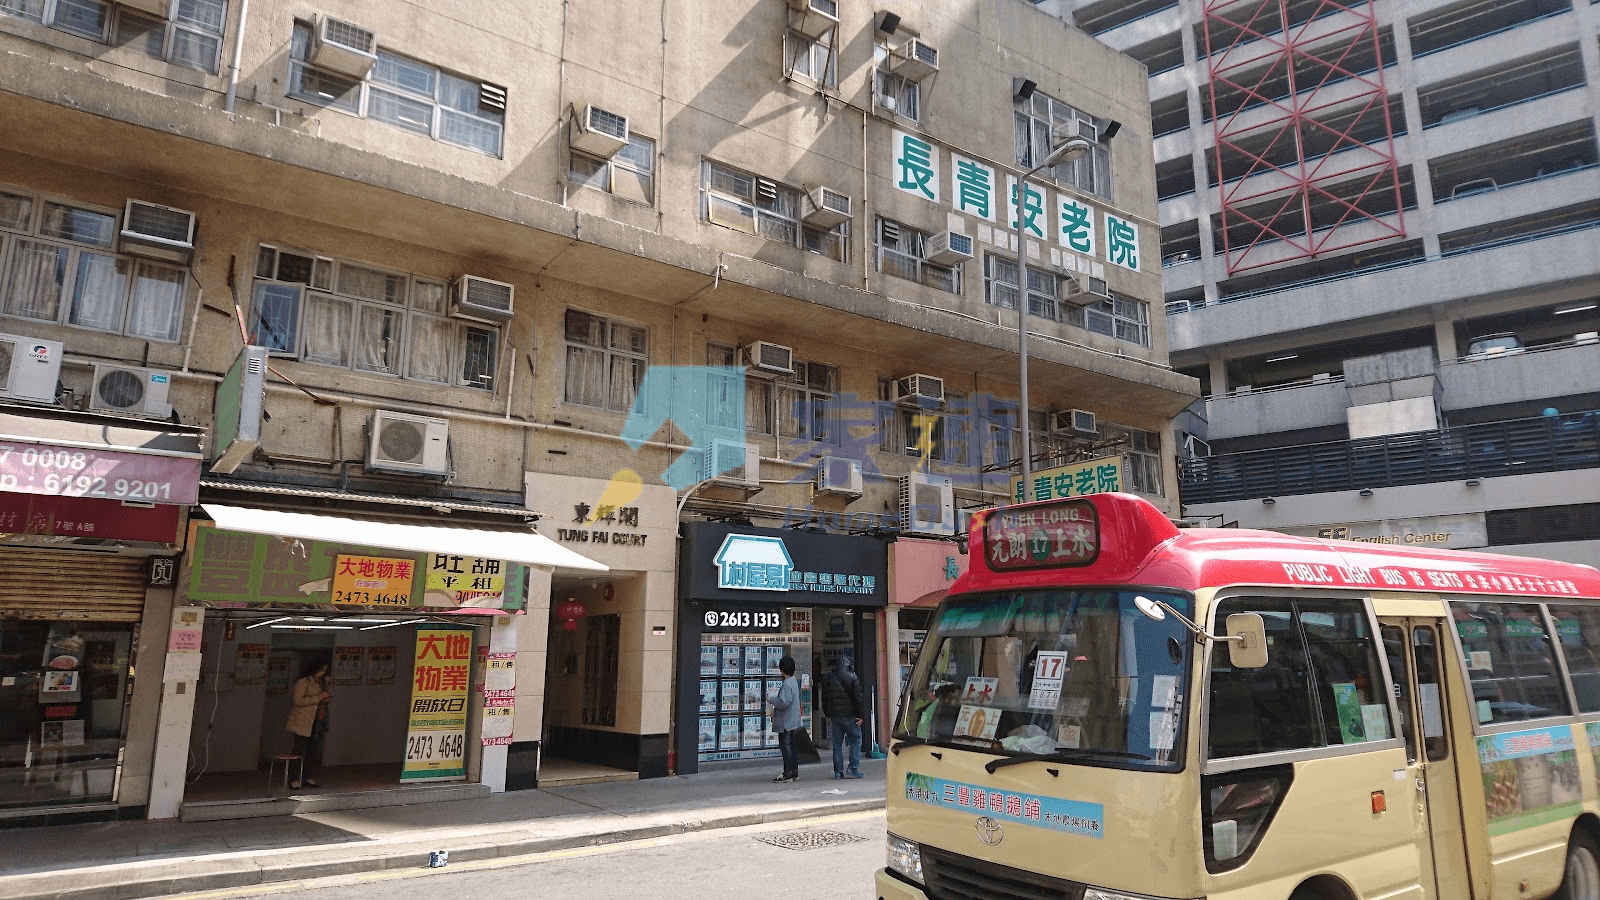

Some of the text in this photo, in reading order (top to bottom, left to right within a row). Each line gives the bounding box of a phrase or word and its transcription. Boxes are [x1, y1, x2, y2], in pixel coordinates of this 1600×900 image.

[898, 135, 1137, 269] 長青安老院
[21, 448, 86, 470] 0008
[44, 473, 106, 495] 6192
[114, 478, 171, 499] 9201
[1002, 508, 1079, 529] YUEN LONG
[557, 528, 648, 546] TUNG FAI COURT
[992, 525, 1094, 562] 元朗 17 上水
[1404, 532, 1451, 543] Center
[338, 558, 411, 579] 大地物業
[729, 561, 784, 588] 村屋易
[1282, 563, 1334, 582] PUBLIC
[1336, 566, 1375, 585] LIGHT
[1380, 568, 1407, 586] BUS
[1408, 570, 1424, 587] 16
[1427, 571, 1464, 588] SEATS
[442, 576, 492, 590] 平租
[810, 584, 836, 593] HOUSE
[837, 585, 875, 595] PROPERTY
[335, 590, 409, 605] 2473 4648
[720, 611, 750, 627] 2613
[754, 612, 780, 627] 1313
[417, 634, 470, 660] 大地
[1041, 658, 1062, 677] 17
[415, 665, 468, 692] 物業
[961, 683, 993, 705] 上水
[412, 698, 466, 713] 開放日
[408, 734, 463, 760] 2473 4648
